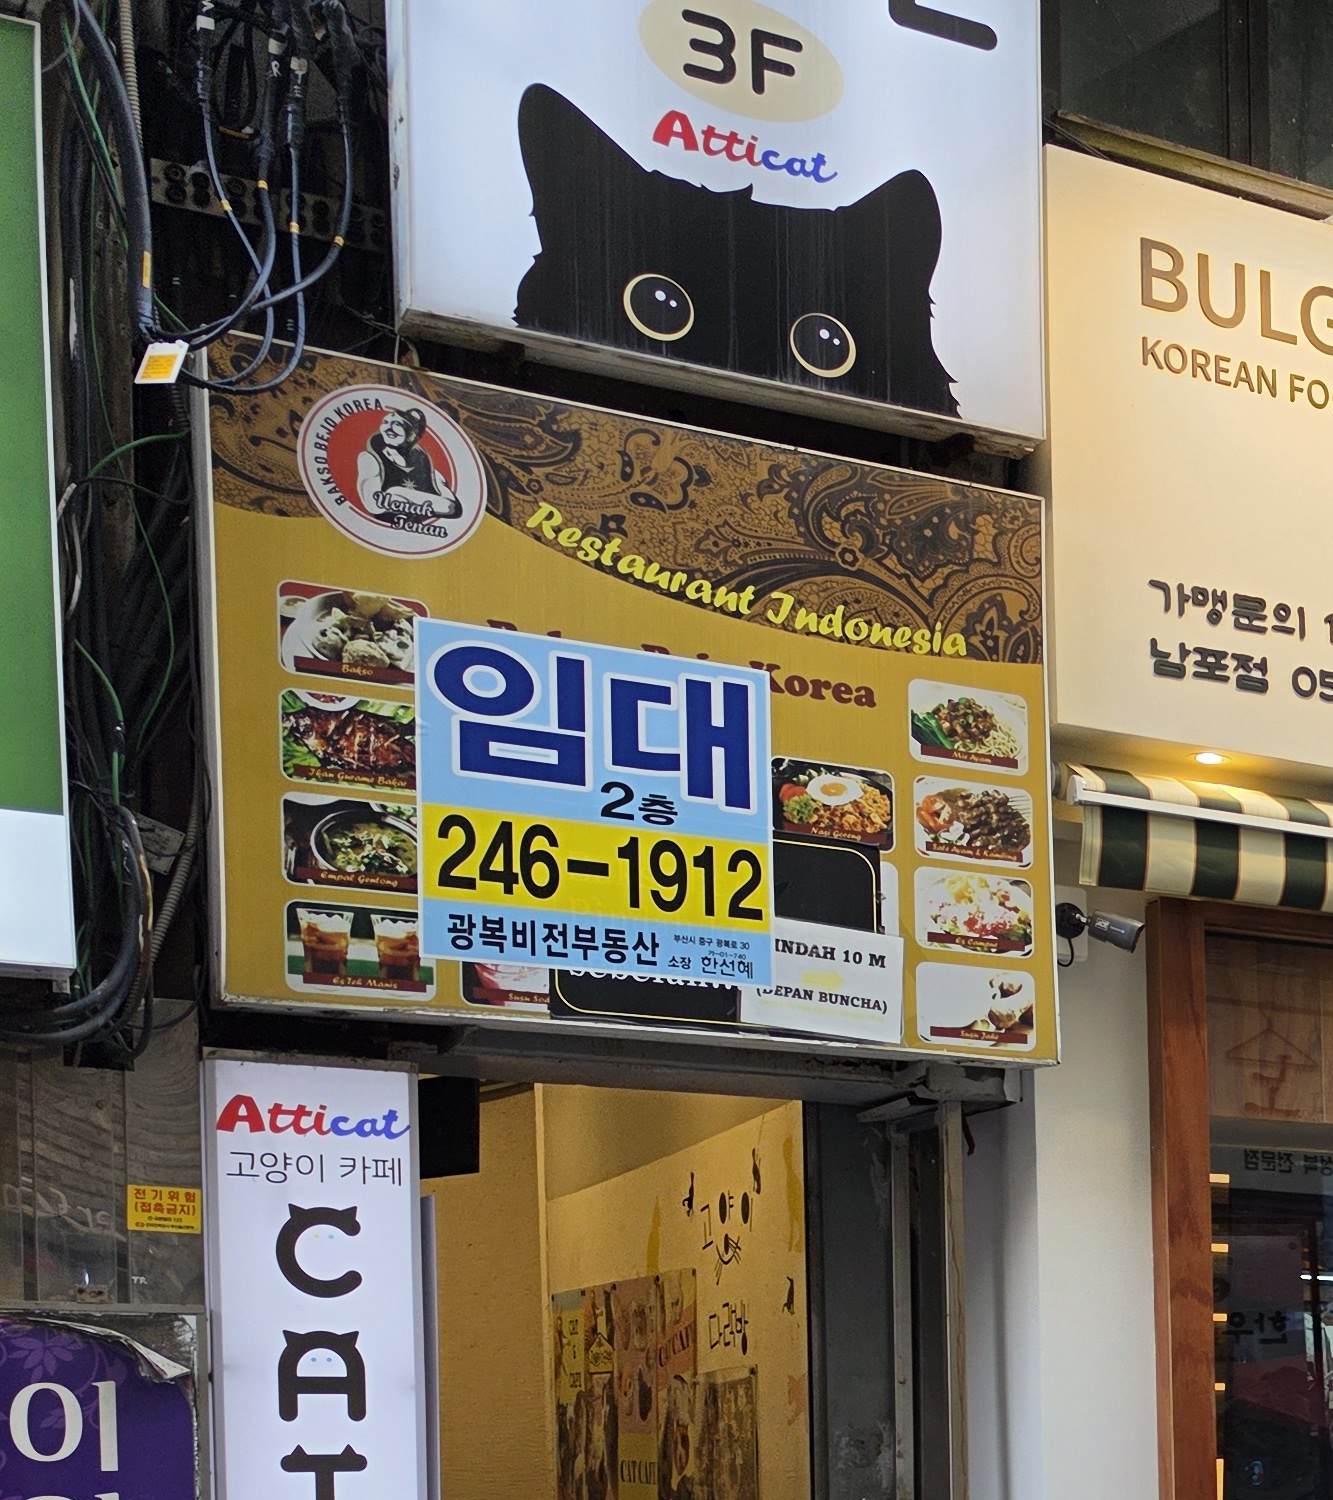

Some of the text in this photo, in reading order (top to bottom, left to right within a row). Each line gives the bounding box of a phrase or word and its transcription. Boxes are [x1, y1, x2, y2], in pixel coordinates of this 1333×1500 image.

[683, 8, 803, 95] 3F
[651, 110, 838, 187] Atticat
[1141, 336, 1278, 399] KOREAN
[313, 397, 384, 508] BAKSO BEJO KOREA
[526, 501, 969, 658] Restaurant Indonesia
[1148, 578, 1307, 641] 가맹문의
[341, 664, 375, 677] Bakso
[750, 660, 878, 708] Korea
[1149, 638, 1270, 695] 남포점
[432, 643, 753, 810] 임대
[600, 780, 679, 827] 2층
[437, 813, 764, 922] 246-1912
[447, 913, 660, 967] 광복비전부동산
[739, 940, 750, 950] 30
[843, 949, 863, 965] 10
[868, 953, 887, 968] M
[667, 954, 754, 980] 소장 한선혜
[818, 991, 888, 1015] BUNCHA)
[215, 1094, 411, 1141] Atticat
[225, 1150, 404, 1187] 고양이 카페
[133, 1201, 197, 1217] (접촉금지)
